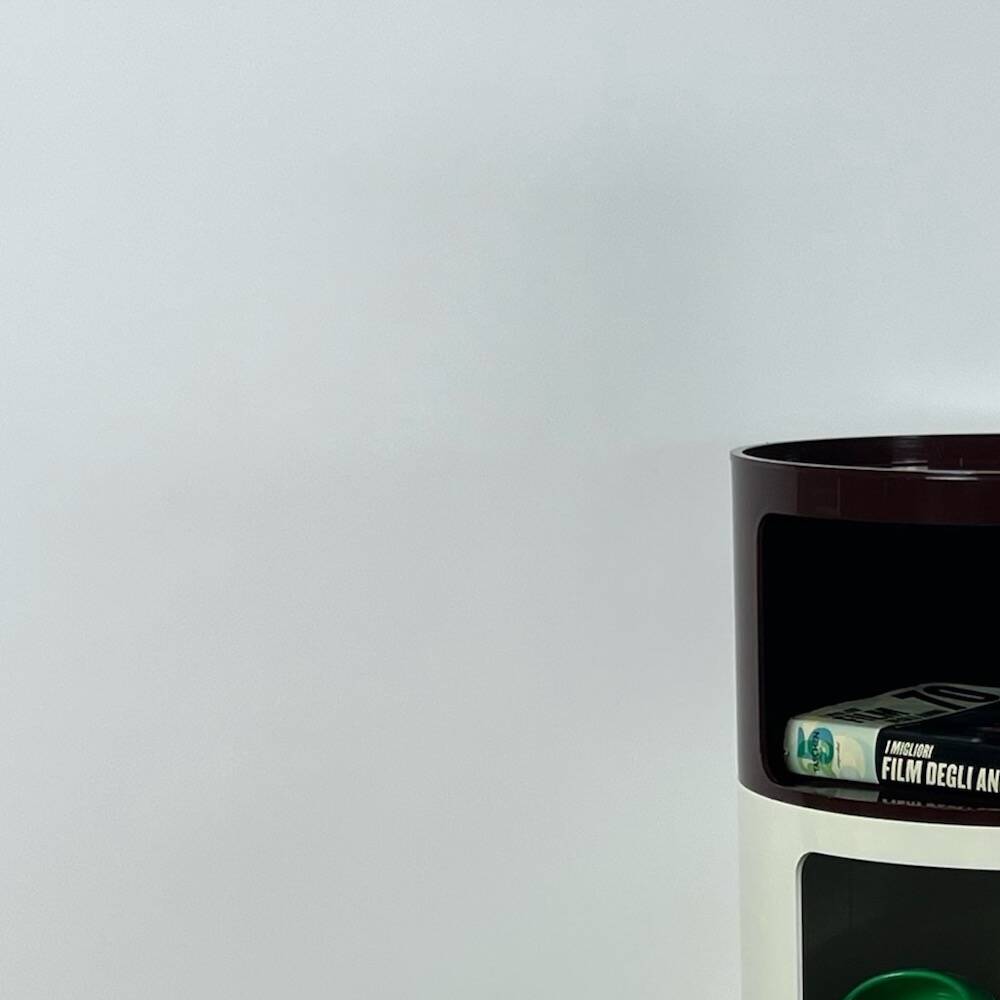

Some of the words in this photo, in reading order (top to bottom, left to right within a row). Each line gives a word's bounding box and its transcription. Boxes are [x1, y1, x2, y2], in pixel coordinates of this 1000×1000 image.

[884, 739, 891, 755] I
[890, 741, 935, 759] MIGLIORI
[881, 756, 923, 784] FILM
[925, 761, 974, 790] DEGLI
